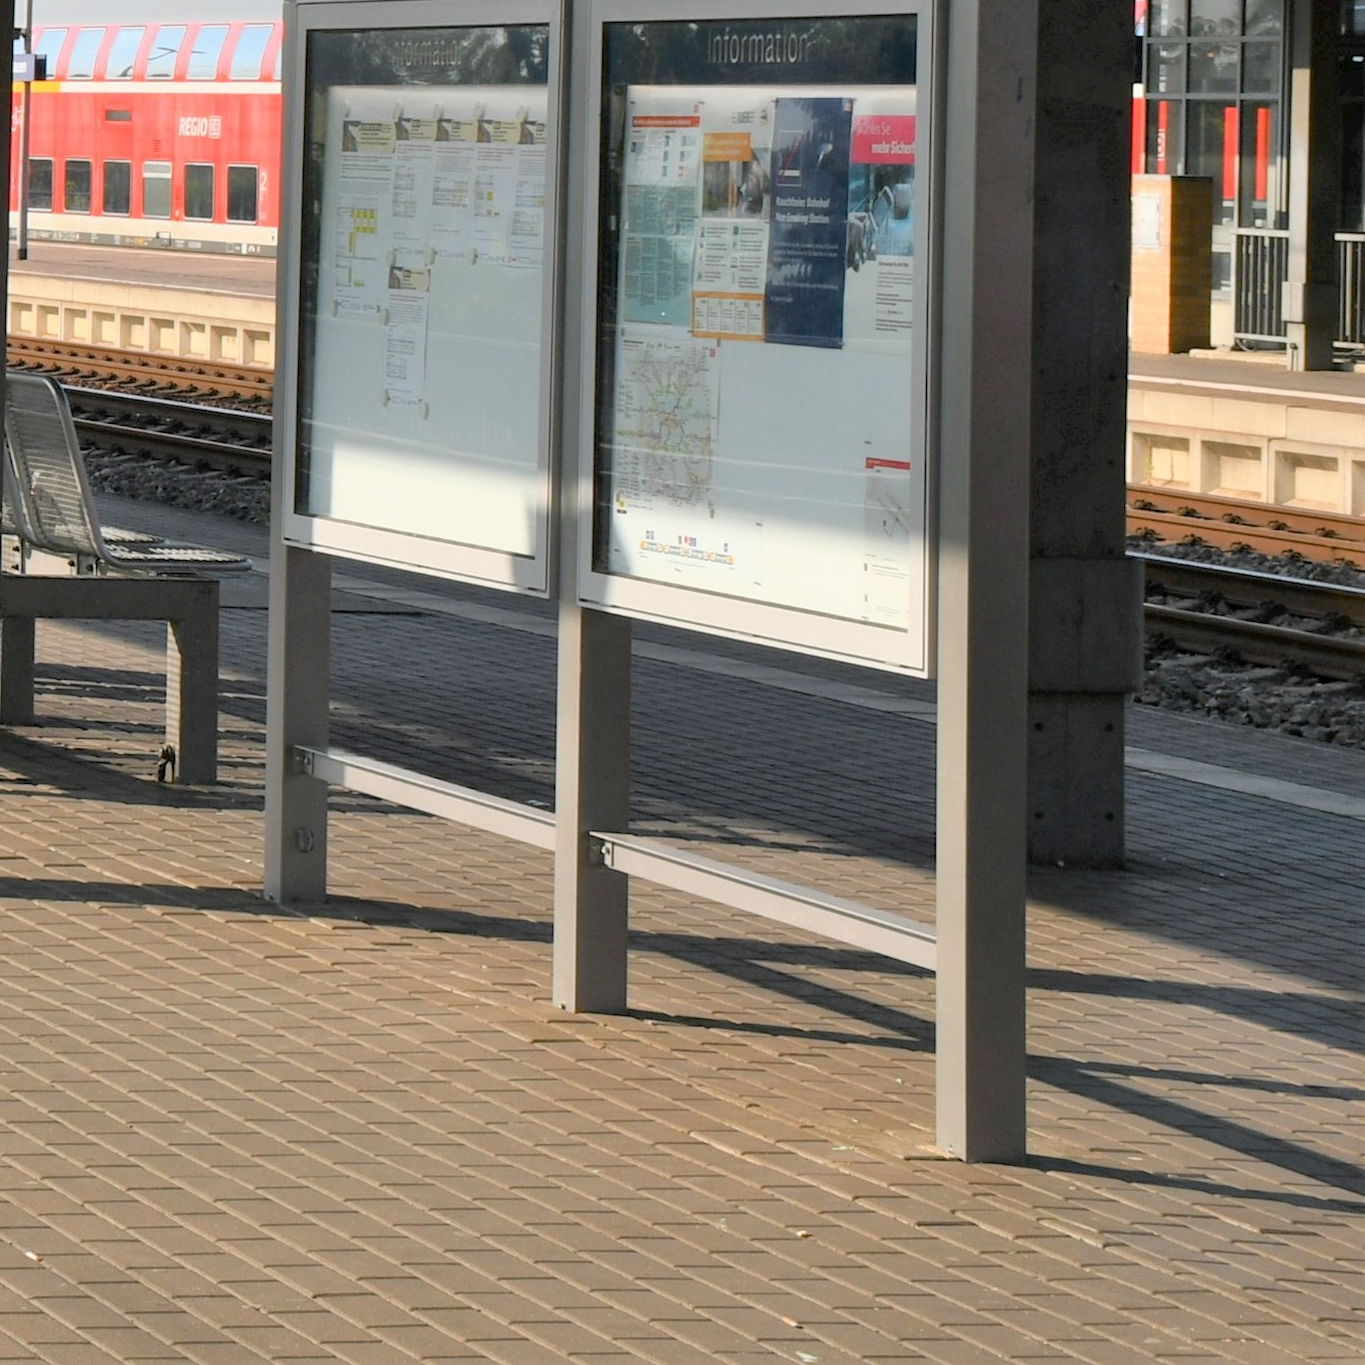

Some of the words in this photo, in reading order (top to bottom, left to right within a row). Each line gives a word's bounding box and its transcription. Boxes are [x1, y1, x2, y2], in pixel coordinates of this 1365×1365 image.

[707, 28, 808, 64] Information
[179, 116, 208, 137] REGIO
[891, 140, 916, 155] Sicher
